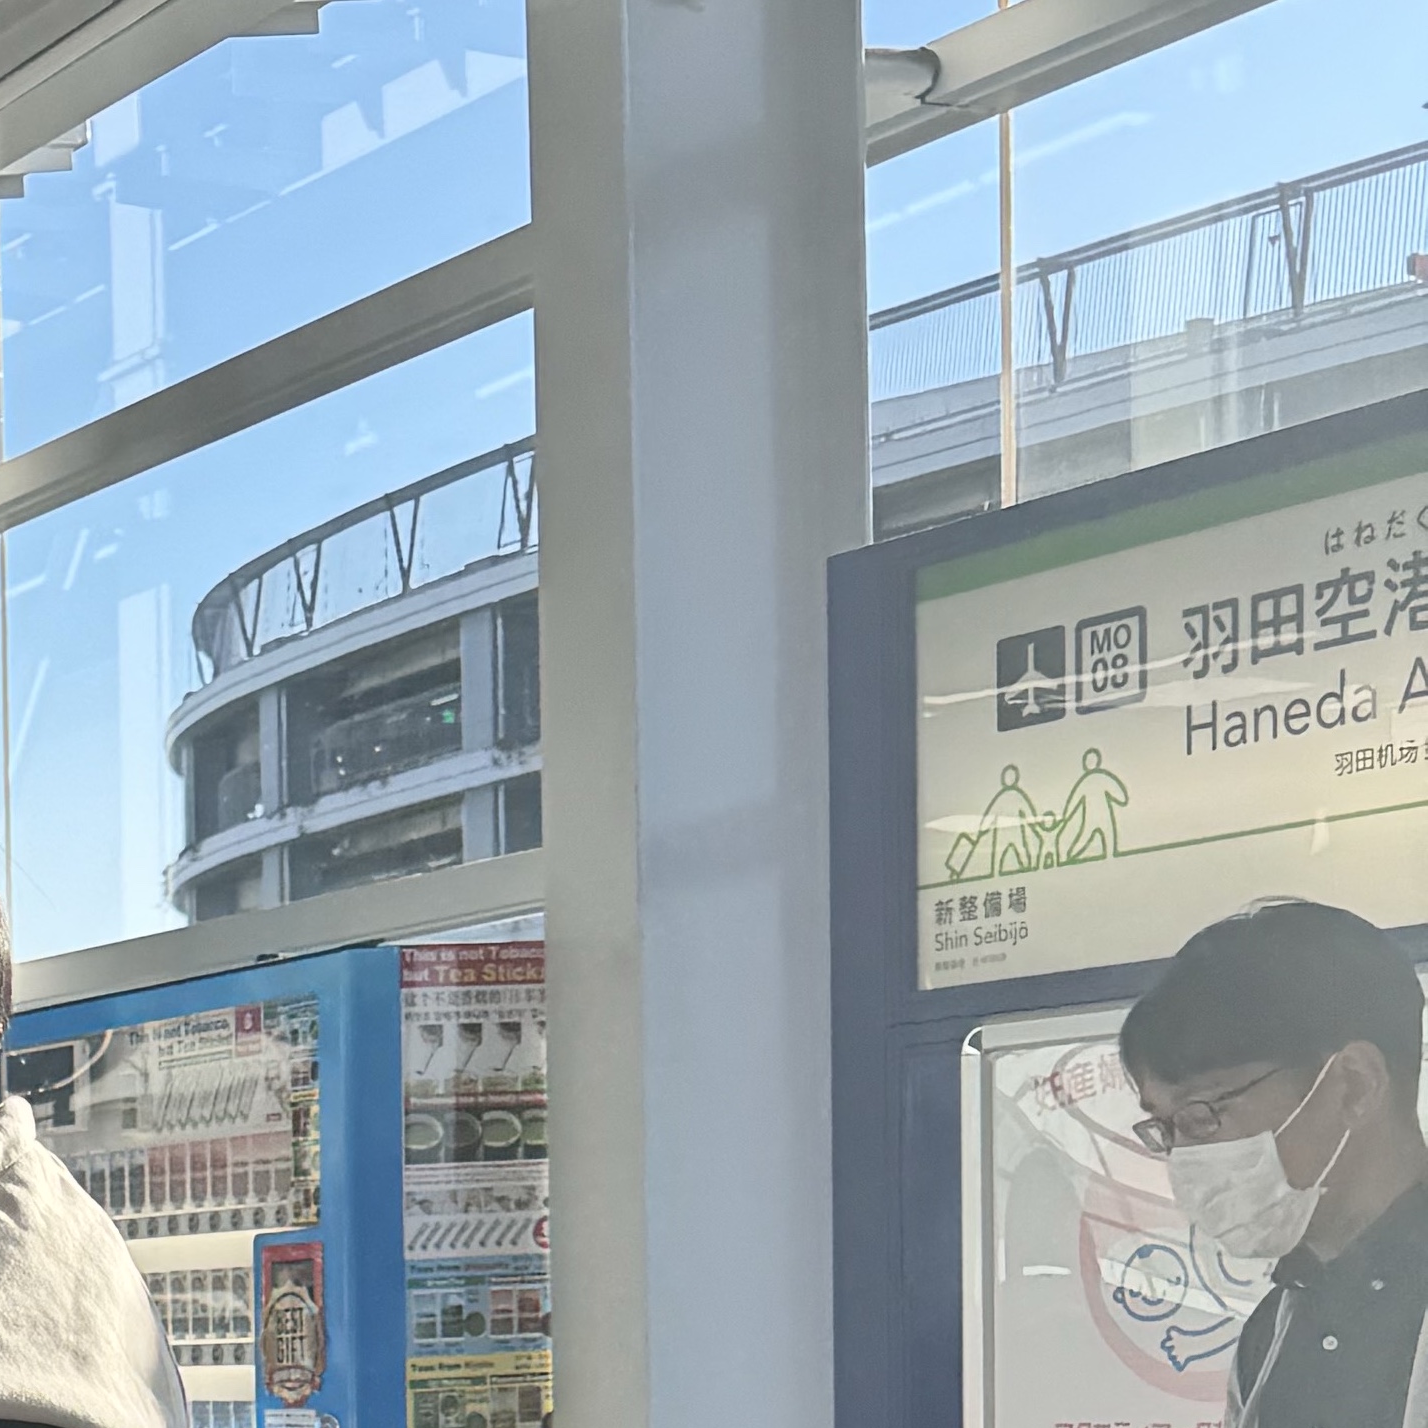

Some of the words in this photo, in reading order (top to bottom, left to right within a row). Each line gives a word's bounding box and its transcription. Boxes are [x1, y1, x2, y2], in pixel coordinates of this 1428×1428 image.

[1089, 622, 1132, 656] MO
[1090, 652, 1130, 693] 08
[1185, 668, 1378, 756] Haneda
[1333, 739, 1428, 777] 羽田机场
[934, 929, 969, 952] Shin
[434, 965, 478, 983] Tea
[275, 1306, 304, 1336] BEST
[276, 1335, 306, 1364] GIFT
